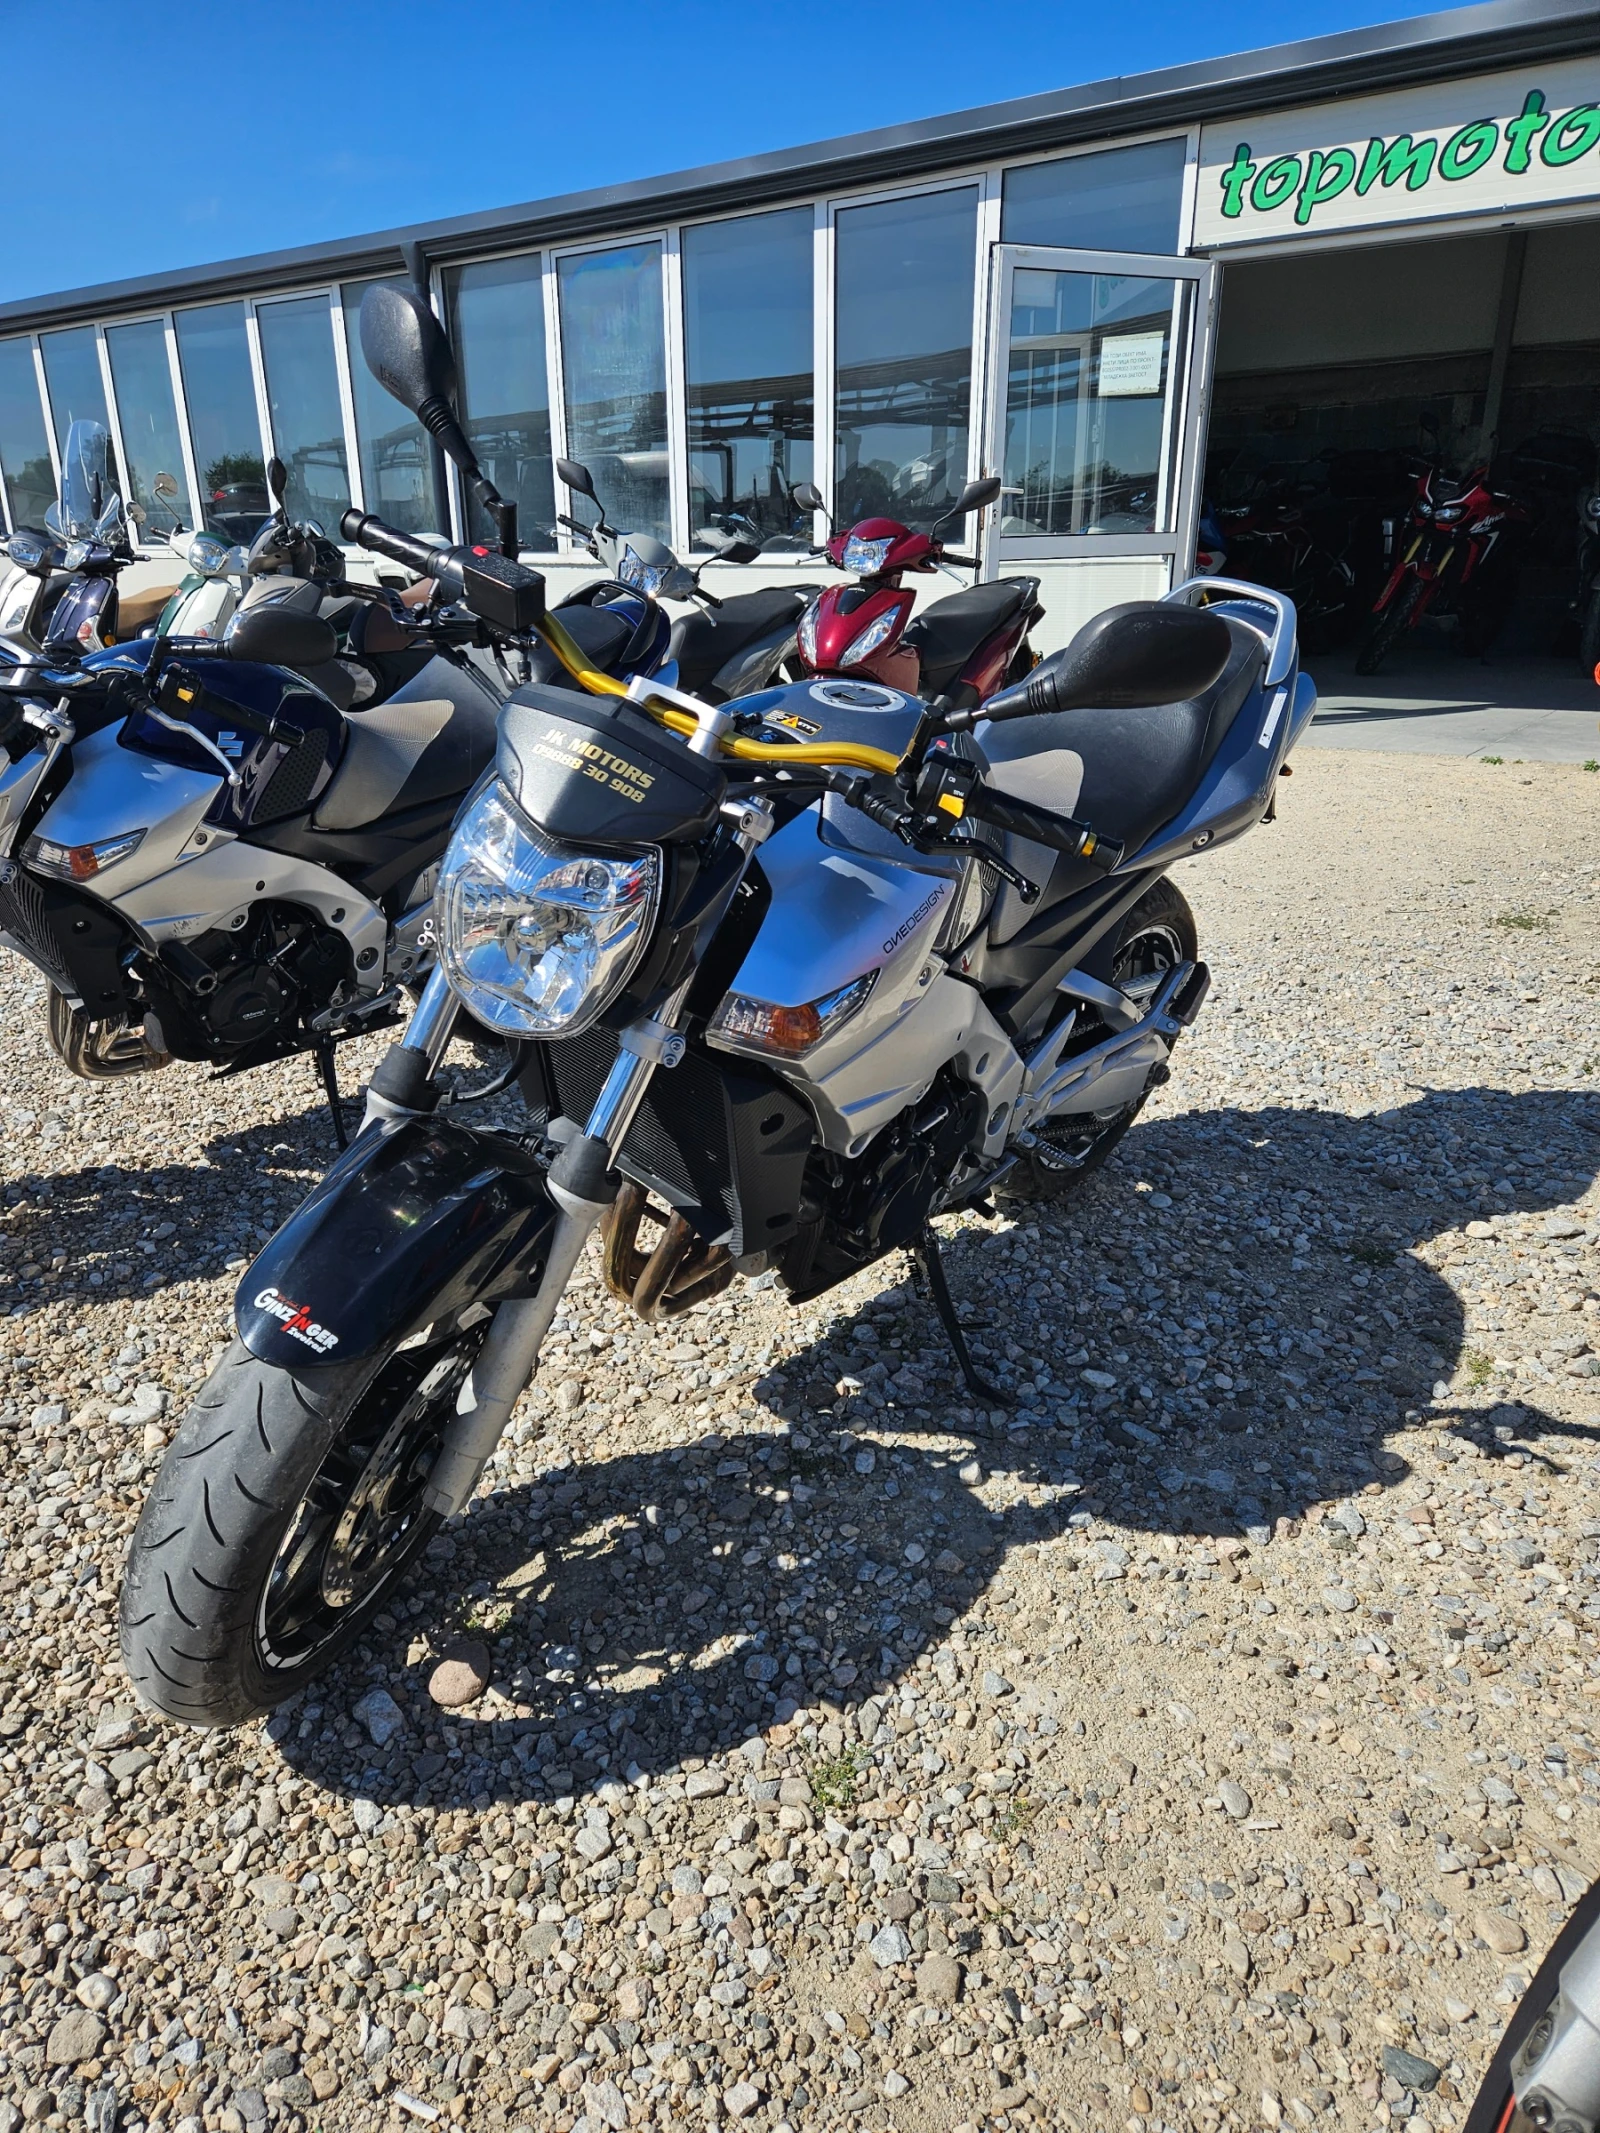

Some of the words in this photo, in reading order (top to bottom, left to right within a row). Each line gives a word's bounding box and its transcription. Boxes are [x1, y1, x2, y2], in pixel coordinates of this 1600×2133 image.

[531, 744, 584, 770] 09888
[583, 764, 610, 783] 30
[608, 778, 646, 803] 908
[540, 729, 567, 746] JK
[567, 738, 656, 789] MOTORS
[882, 884, 945, 954] ONEDESIGN
